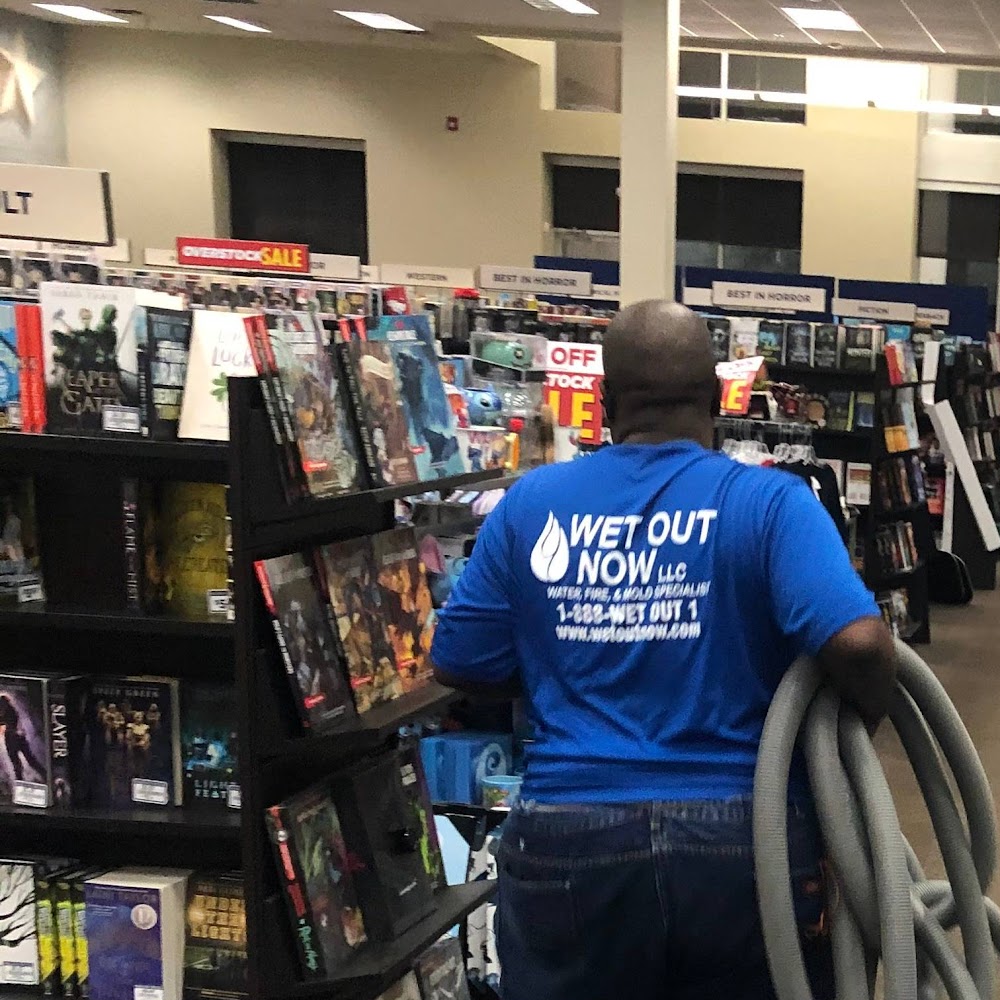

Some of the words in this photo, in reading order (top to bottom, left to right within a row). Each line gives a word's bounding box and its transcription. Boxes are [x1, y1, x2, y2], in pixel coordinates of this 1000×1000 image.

[182, 246, 261, 262] OVERSTOCK
[260, 247, 303, 268] SALE
[406, 272, 447, 282] WESTERN
[493, 273, 517, 283] BEST
[521, 276, 531, 284] IN
[534, 277, 577, 287] HORROR
[727, 289, 751, 299] BEST
[754, 291, 766, 300] IN
[768, 292, 811, 303] HORROR
[858, 306, 889, 315] FICTION
[551, 347, 596, 367] OFF
[570, 513, 644, 549] WET
[648, 509, 718, 546] OUT
[577, 548, 657, 586] NOW
[658, 562, 688, 582] LLC
[547, 585, 583, 600] WATER,
[612, 587, 622, 601] &
[623, 585, 653, 601] MOLD
[650, 600, 683, 622] OUT
[687, 599, 698, 620] 1
[51, 703, 67, 758] SLAYER
